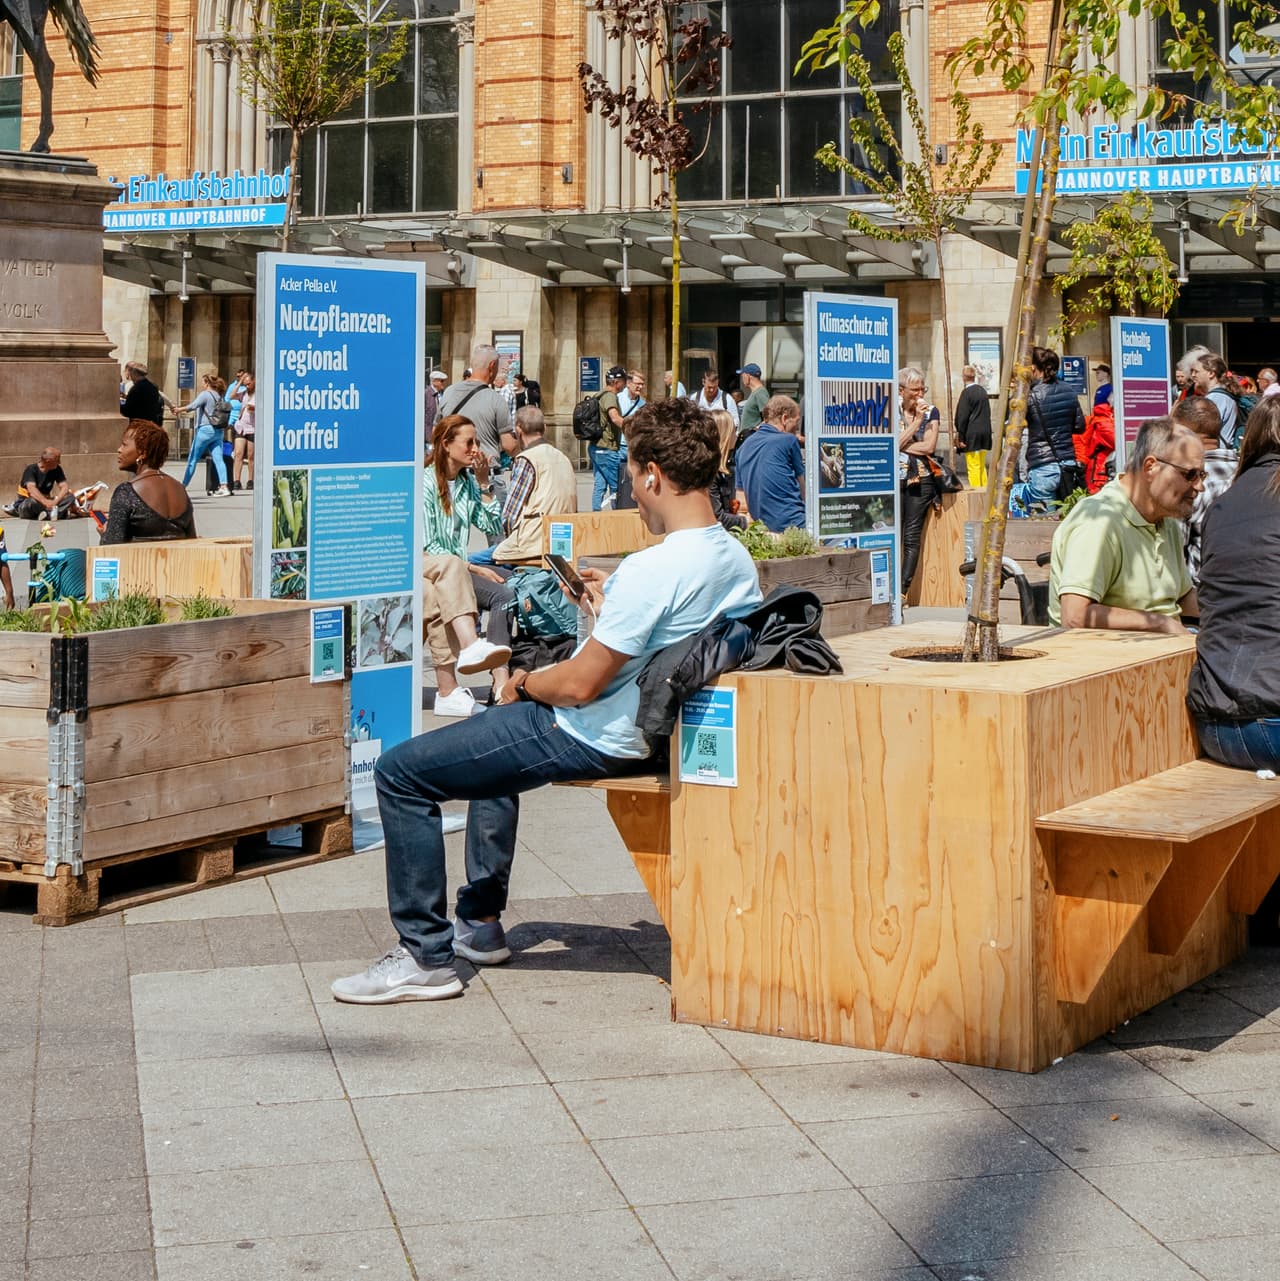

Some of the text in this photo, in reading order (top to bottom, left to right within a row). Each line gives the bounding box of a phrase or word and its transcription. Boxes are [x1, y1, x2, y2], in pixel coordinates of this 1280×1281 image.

[1015, 123, 1087, 163] Min
[128, 166, 291, 204] Einkaufsbahnhof
[1056, 167, 1150, 190] HANNOVER
[103, 207, 267, 228] HANNOVER HAUPTBAHNHOF
[280, 277, 338, 294] Acker Pella e.V.
[279, 303, 392, 339] Nutzpflanzen:
[819, 312, 889, 337] Klimaschutz mit
[279, 343, 348, 378] regional
[819, 342, 890, 365] starken Wurzeln
[278, 381, 360, 411] historisch
[278, 421, 339, 451] torffrei
